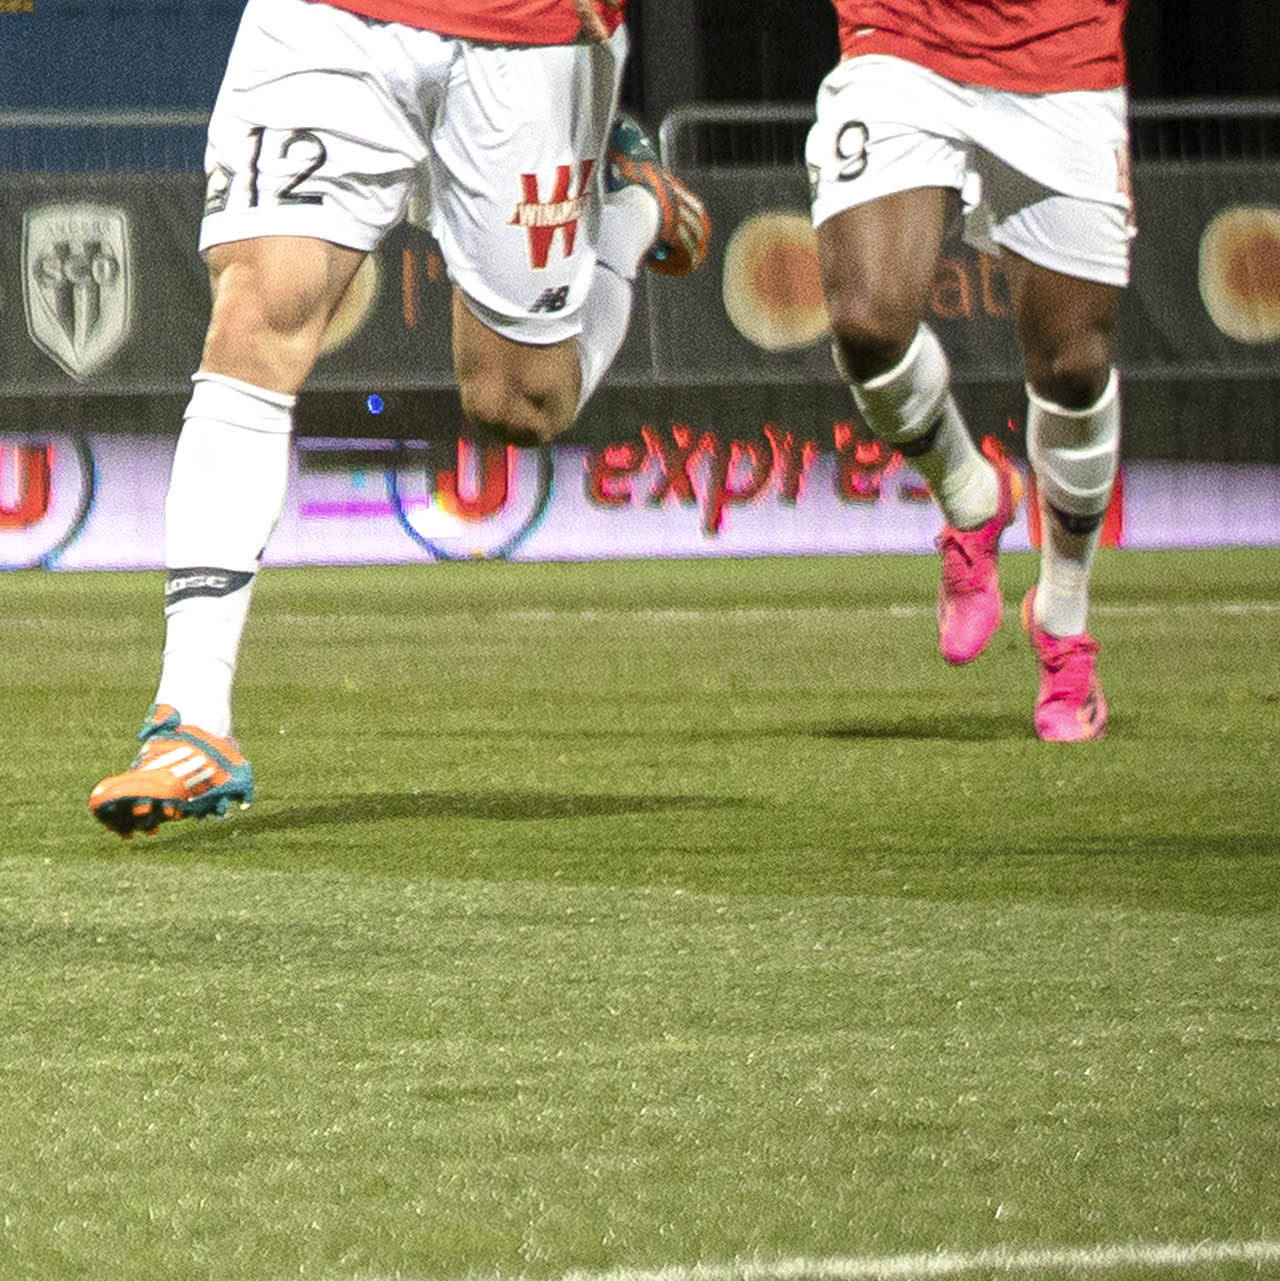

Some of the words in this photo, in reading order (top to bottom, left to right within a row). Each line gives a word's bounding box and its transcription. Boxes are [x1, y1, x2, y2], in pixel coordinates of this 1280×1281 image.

[247, 126, 327, 207] 12
[835, 120, 870, 183] 9
[584, 422, 935, 539] expre
